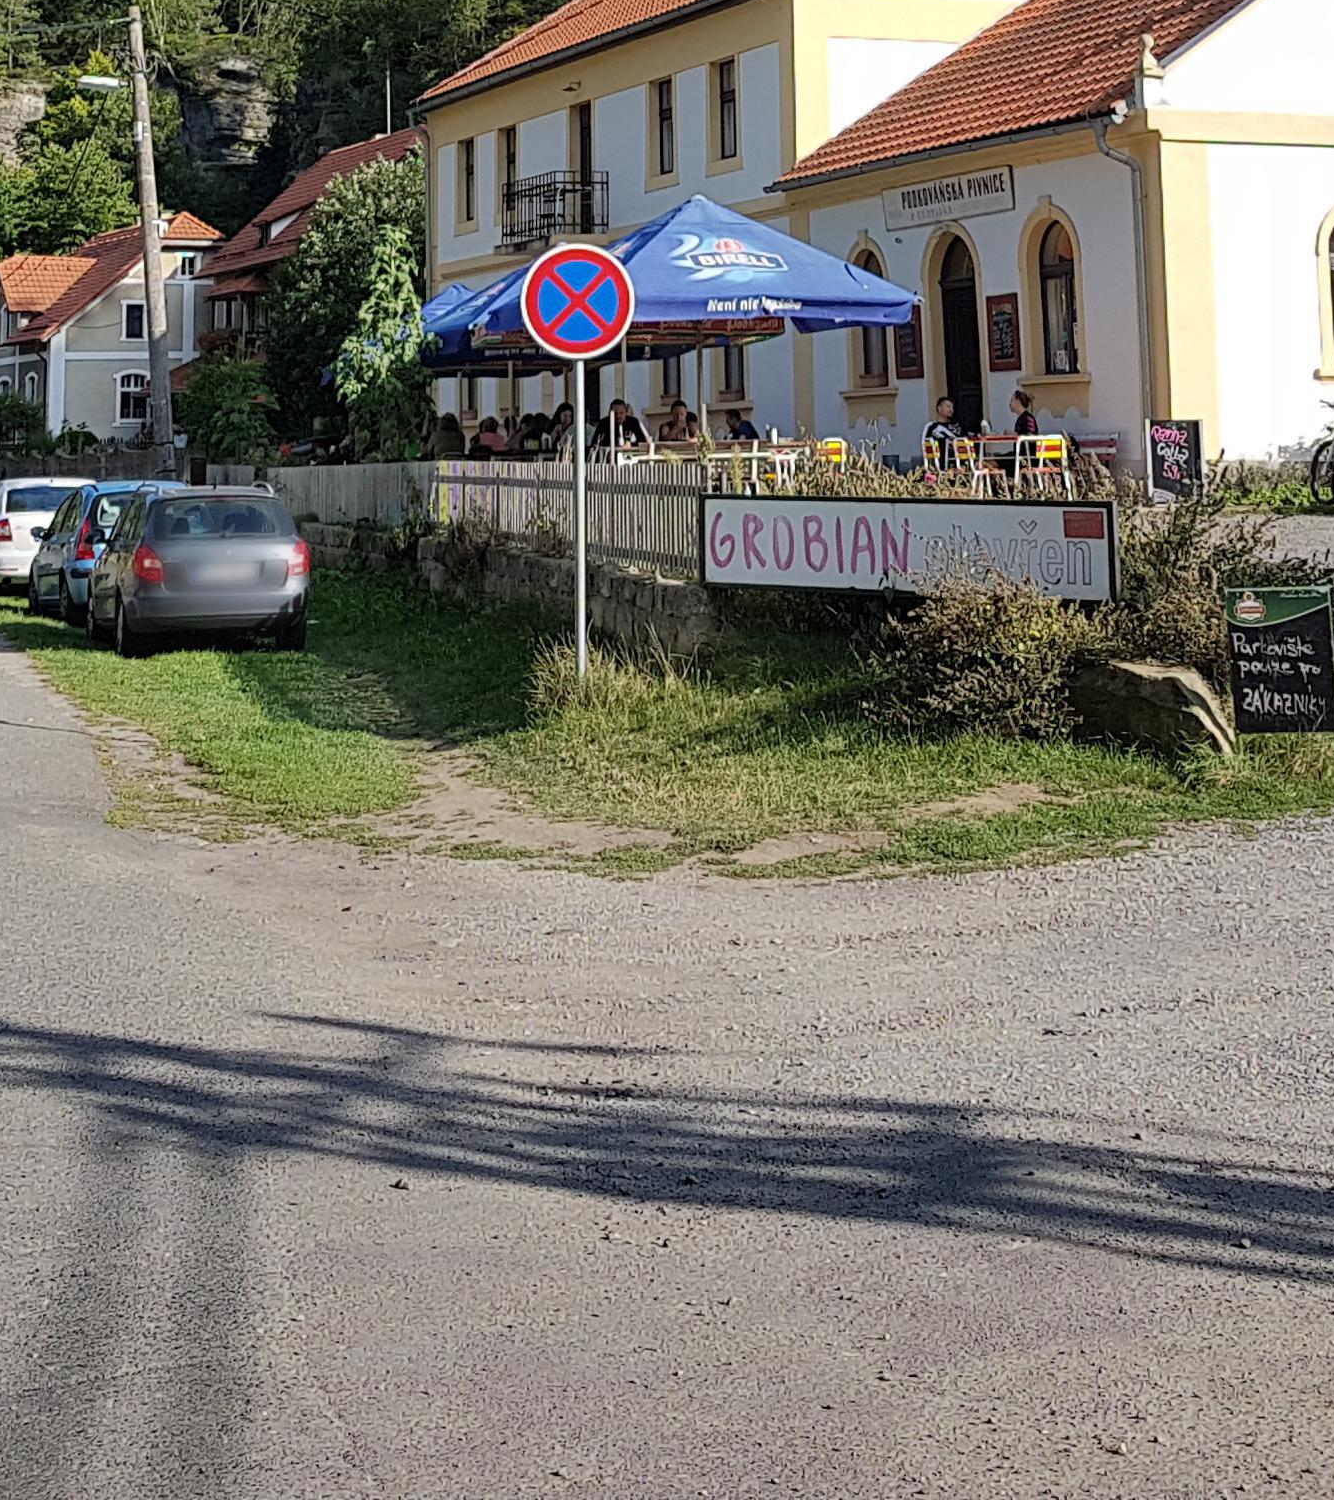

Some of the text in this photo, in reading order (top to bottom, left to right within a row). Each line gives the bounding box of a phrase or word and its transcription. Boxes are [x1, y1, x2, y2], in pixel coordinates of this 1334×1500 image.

[967, 173, 1005, 198] PIVNICE
[699, 254, 776, 267] BIRELL
[709, 511, 911, 576] GROBIAN
[1297, 662, 1322, 683] pro
